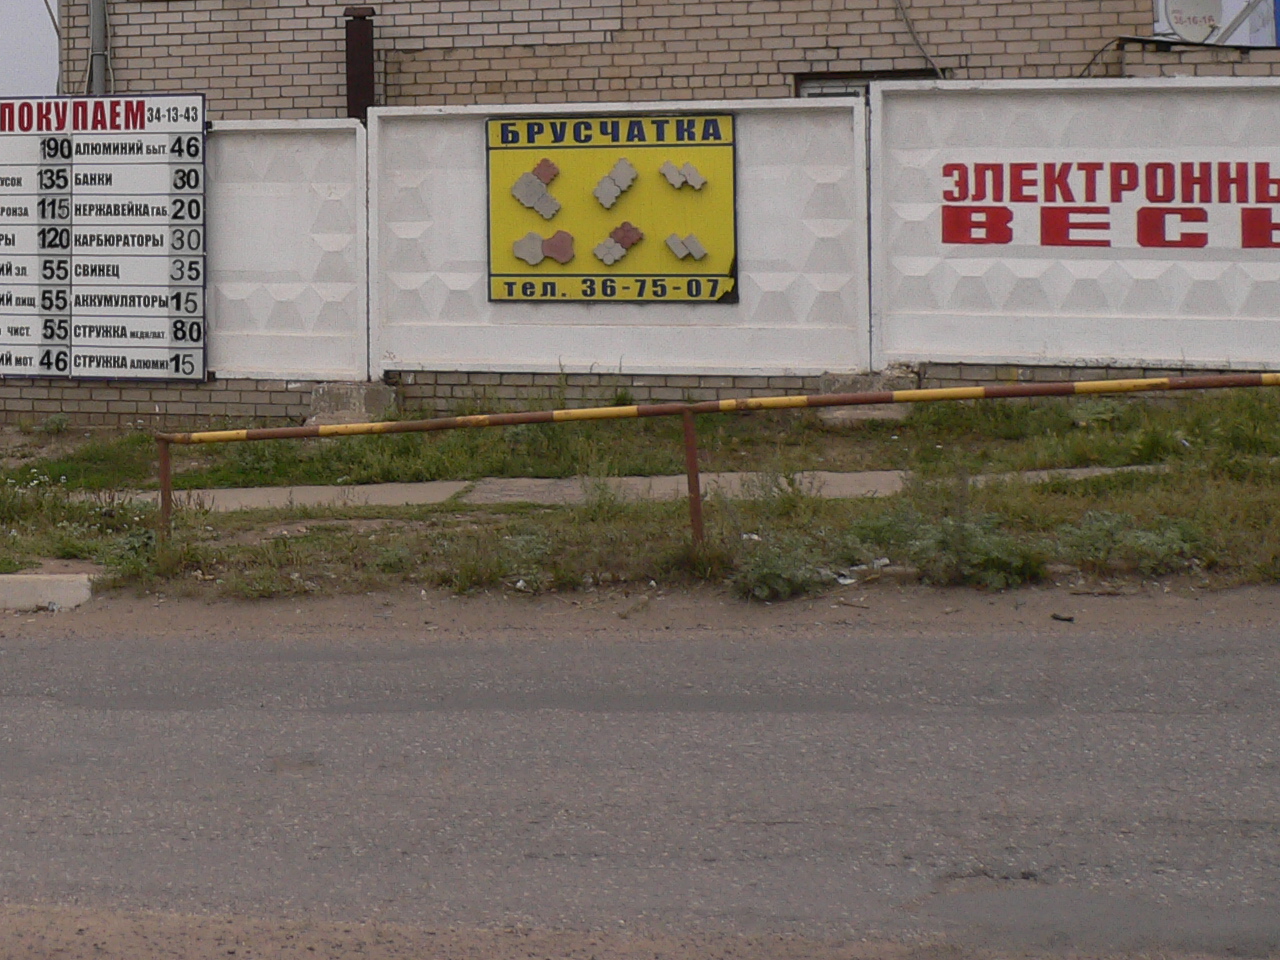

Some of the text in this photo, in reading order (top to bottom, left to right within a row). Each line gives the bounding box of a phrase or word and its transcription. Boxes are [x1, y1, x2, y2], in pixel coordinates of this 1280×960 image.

[0, 100, 145, 132] ПОКУПАЕМ
[147, 106, 198, 122] 34-13-43
[500, 119, 722, 144] БРУСЧАТКА
[40, 137, 72, 159] 190
[74, 140, 143, 155] АЛЮМИНИЙ
[170, 136, 200, 157] 46
[37, 168, 68, 190] 135
[74, 168, 199, 190] БАНКИ 30
[37, 197, 69, 220] 115
[74, 201, 150, 216] НЕРЖАВЕЙКА
[171, 198, 200, 220] 20
[37, 227, 70, 249] 120
[74, 228, 200, 250] КАРБЮРАТОРЫ 30
[42, 259, 69, 280] 55
[74, 259, 200, 281] СВИНЕЦ 35
[504, 278, 721, 297] тел. 36-75-07
[41, 289, 68, 311] 55
[73, 292, 198, 314] АККУМУЛЯТОРЫ 15
[42, 319, 69, 340] 55
[73, 325, 128, 339] СТРУЖКА
[172, 319, 202, 343] 80
[39, 348, 69, 372] 46
[73, 354, 128, 369] СТРУЖКА
[170, 353, 195, 376] 15
